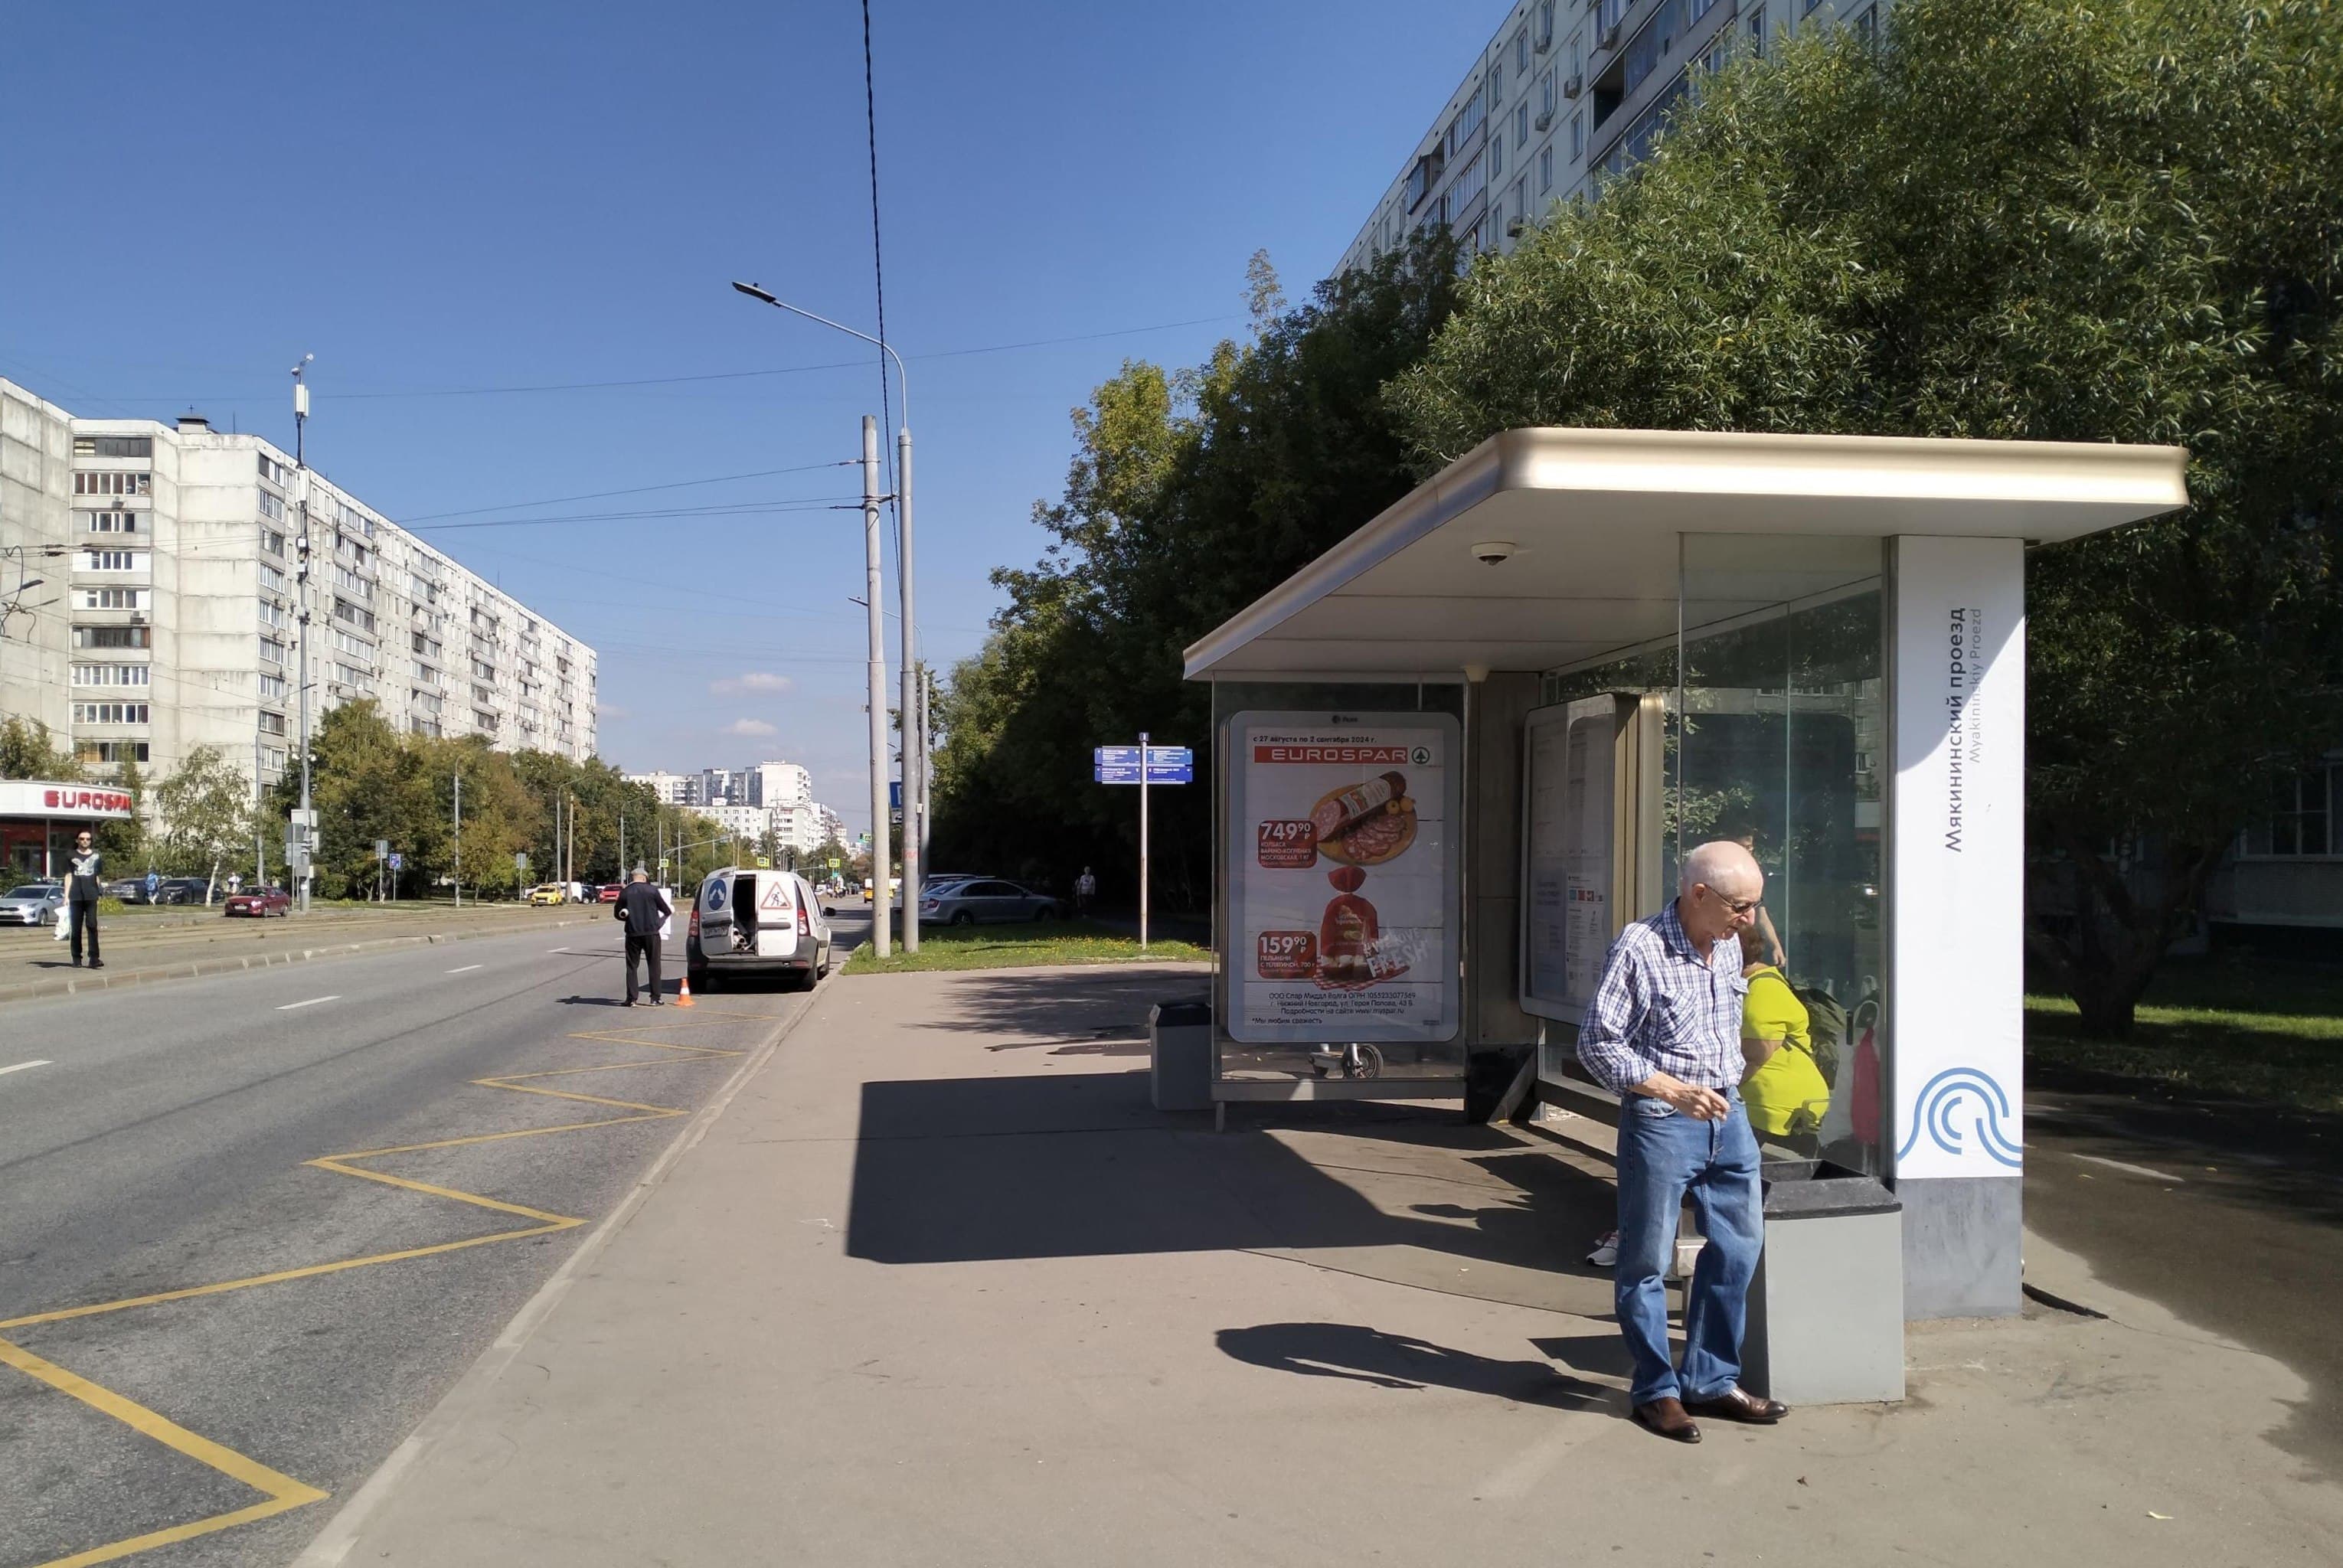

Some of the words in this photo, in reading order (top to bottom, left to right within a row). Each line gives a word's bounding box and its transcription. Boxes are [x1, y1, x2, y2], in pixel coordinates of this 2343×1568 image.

[1950, 607, 1966, 688] проезд
[1969, 609, 1982, 660] Proezd
[1969, 664, 1984, 763] Myakininskiy
[1271, 748, 1407, 761] EUROSPAR
[1316, 736, 1350, 744] сентября
[1351, 735, 1370, 743] 2024
[1945, 695, 1962, 852] Мякининский
[1260, 822, 1298, 840] 749
[1260, 936, 1293, 954] 159
